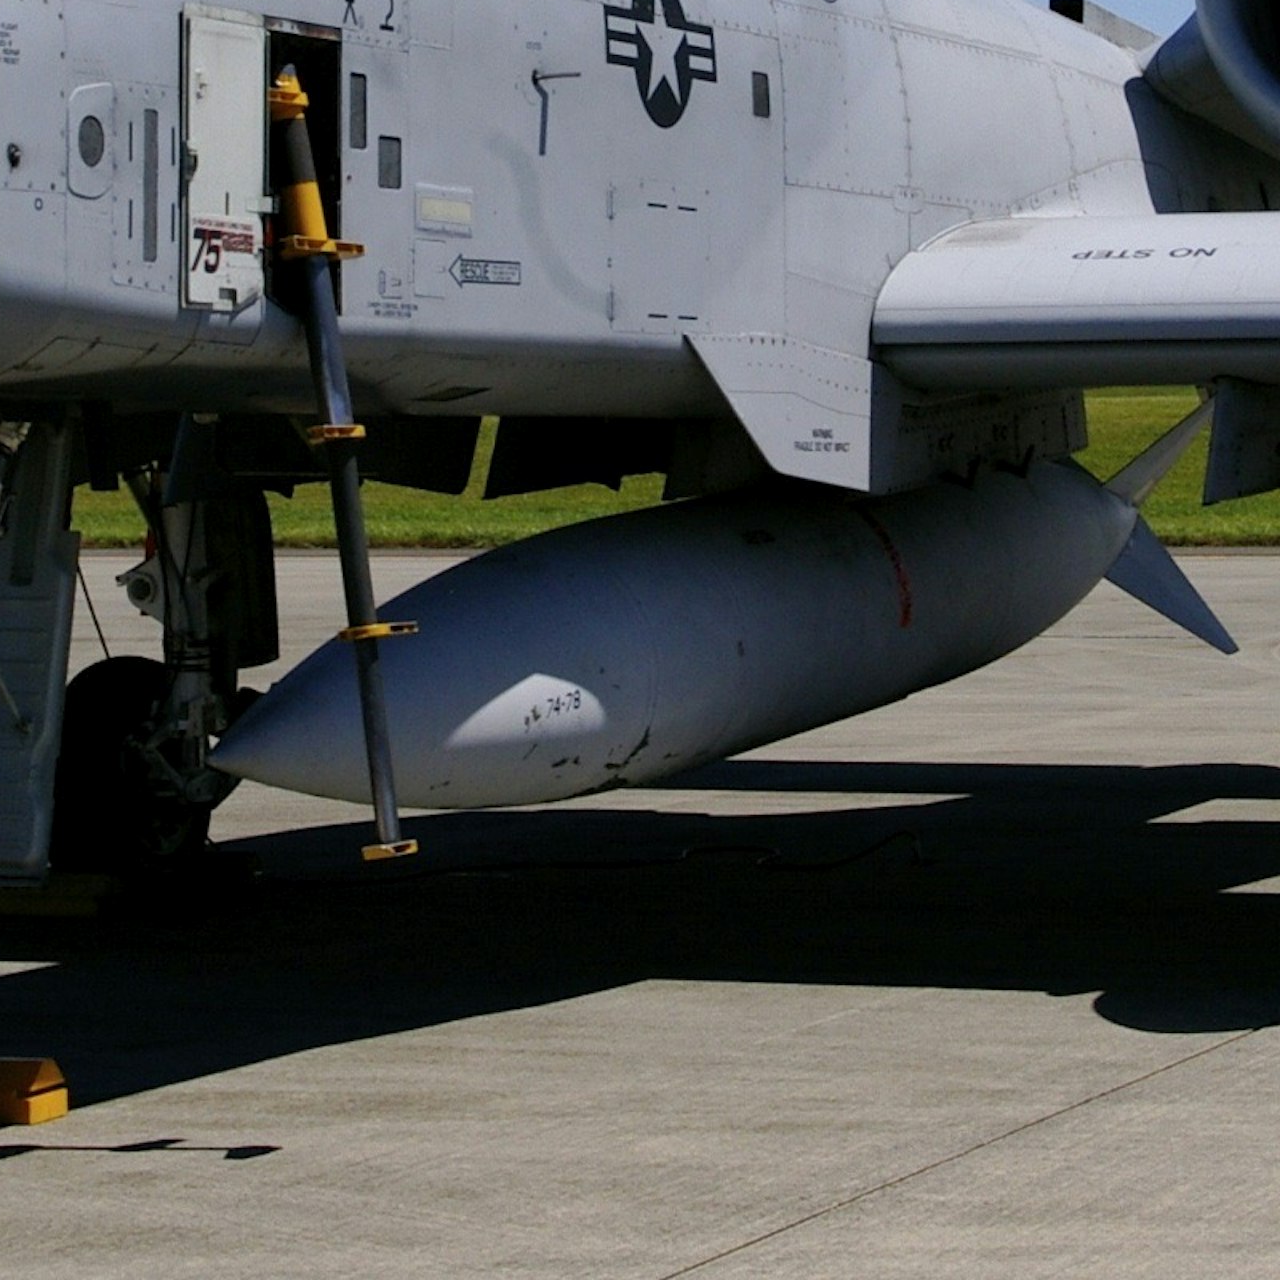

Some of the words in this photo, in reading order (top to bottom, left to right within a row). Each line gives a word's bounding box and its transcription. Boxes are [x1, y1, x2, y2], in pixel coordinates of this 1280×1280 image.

[192, 227, 221, 274] 75
[1071, 249, 1154, 260] STEP
[1169, 247, 1217, 258] NO
